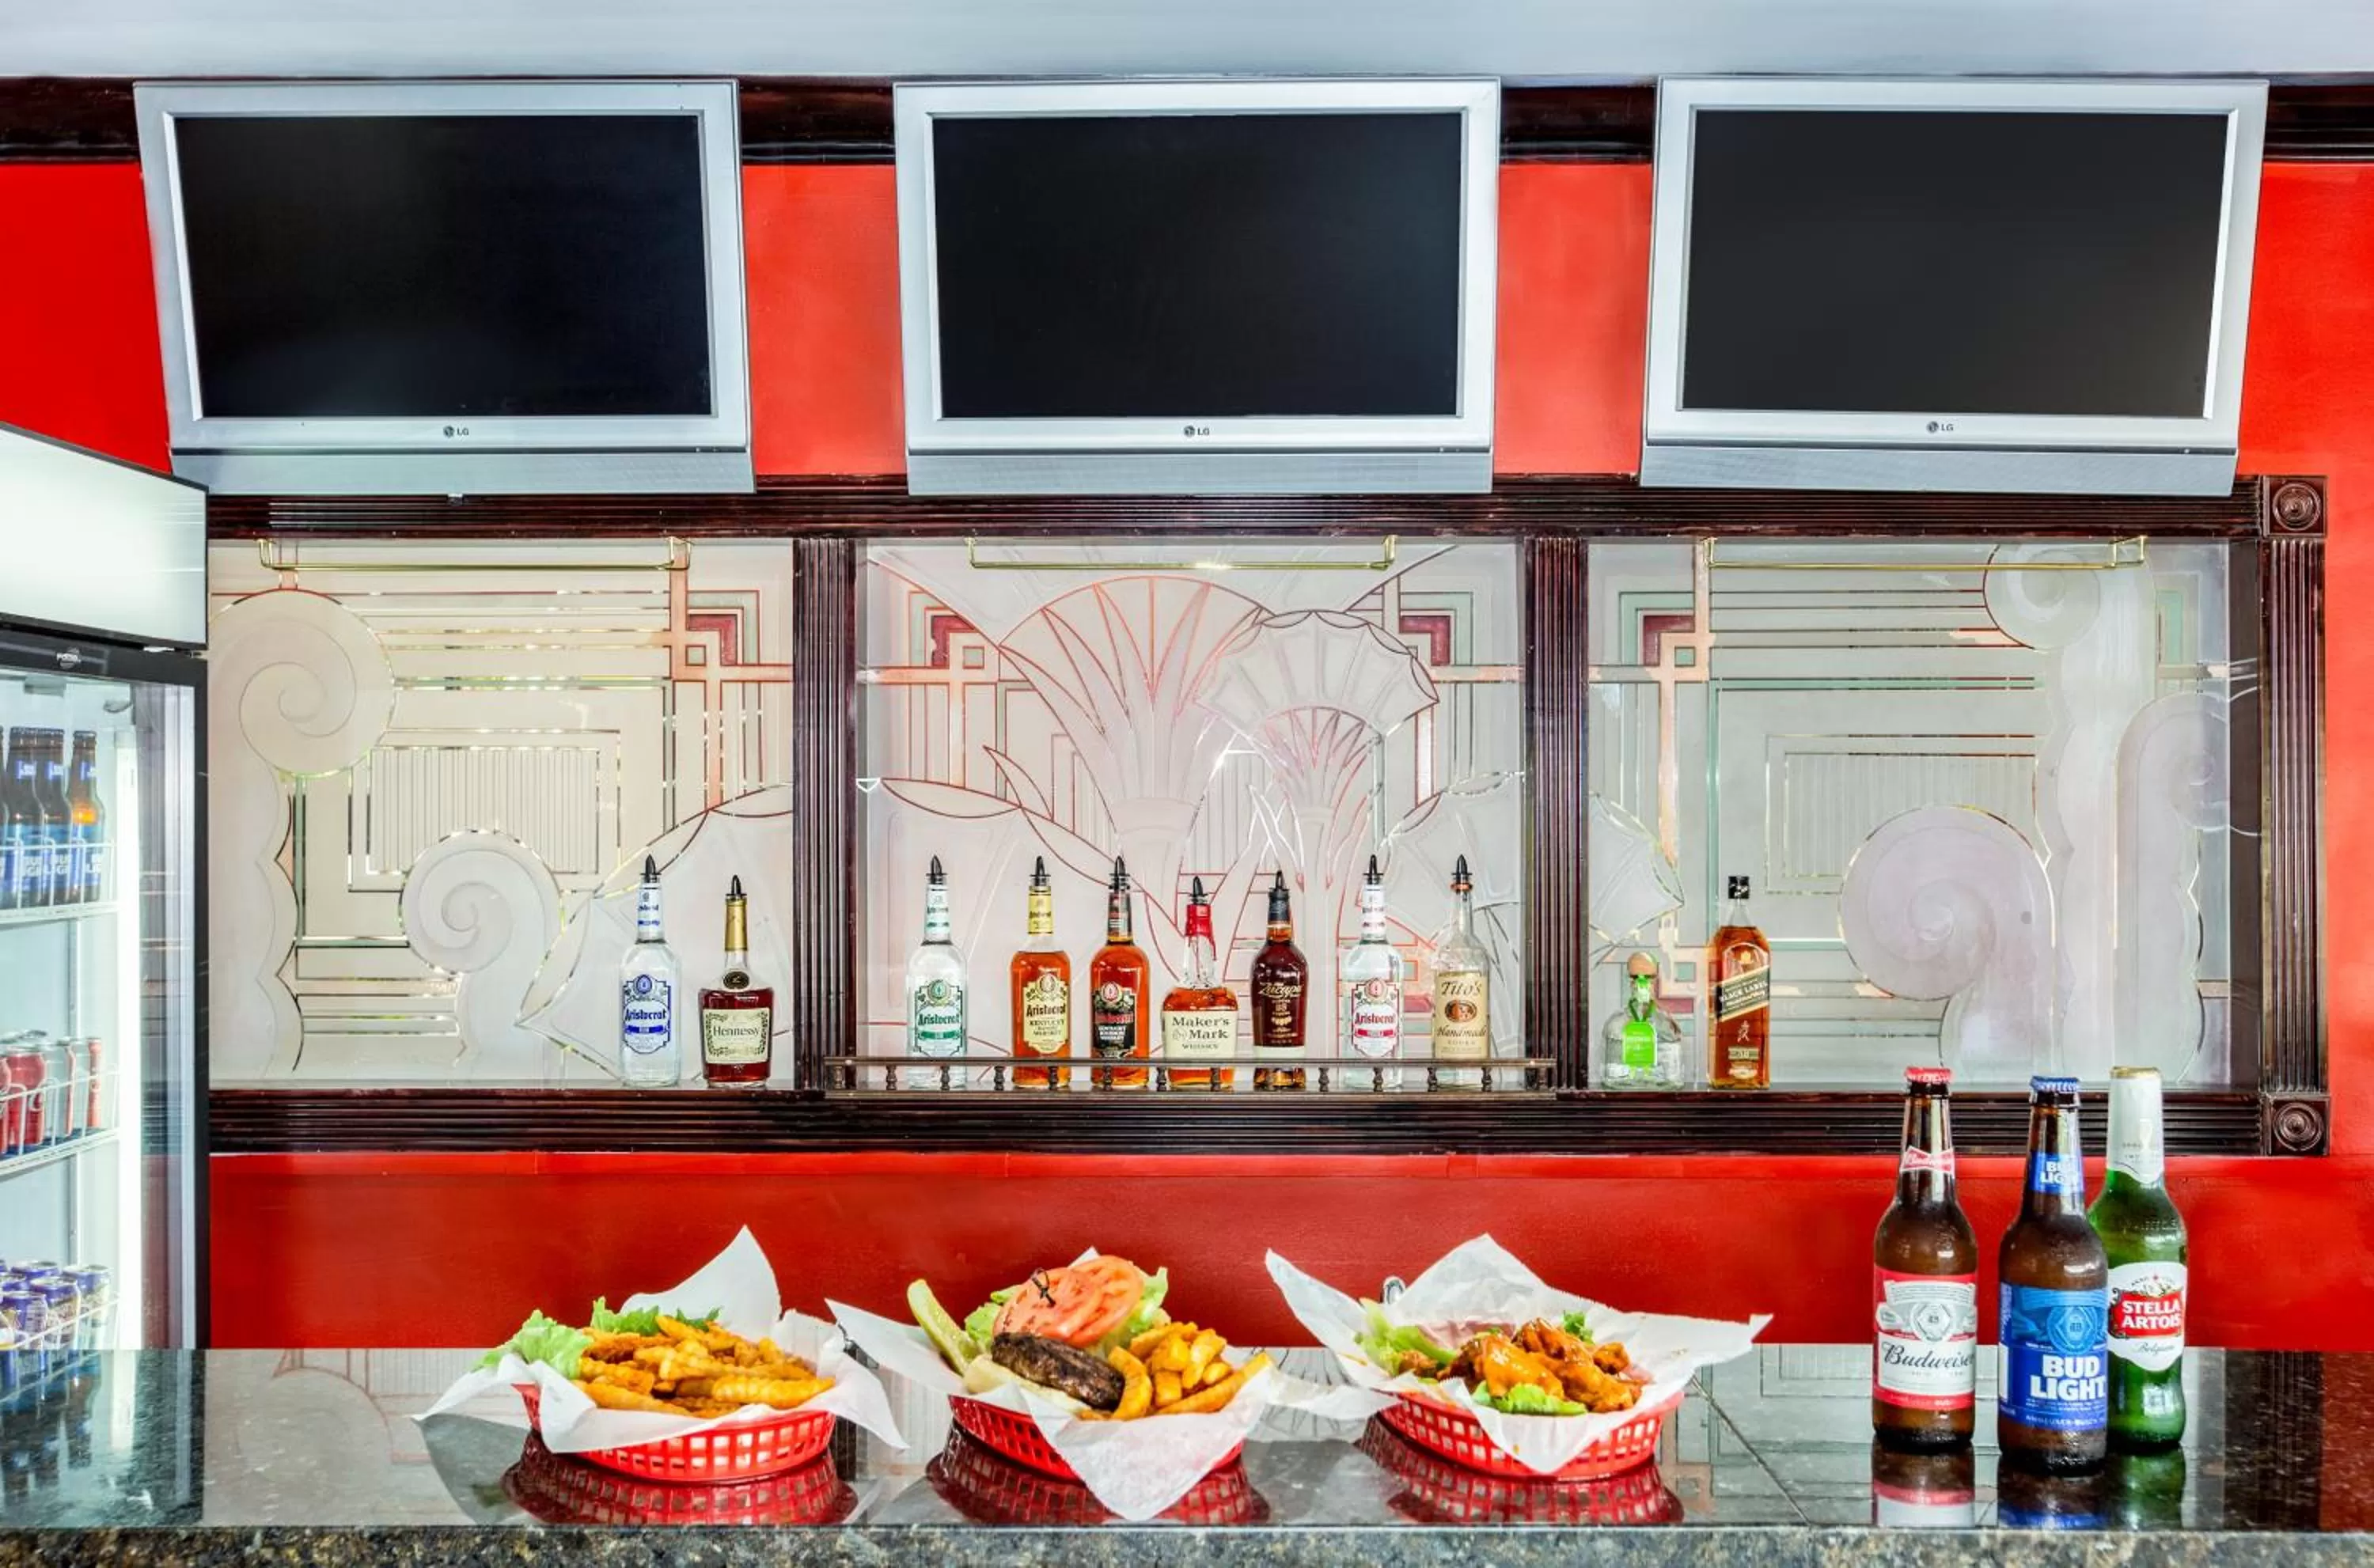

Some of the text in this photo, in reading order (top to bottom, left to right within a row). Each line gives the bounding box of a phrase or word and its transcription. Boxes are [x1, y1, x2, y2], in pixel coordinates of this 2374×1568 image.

[457, 427, 469, 436] LG
[1197, 427, 1210, 436] LG
[624, 1009, 666, 1021] Aristocrat
[918, 1013, 960, 1026] Aristocrat
[1172, 1017, 1230, 1027] Maker's
[713, 1025, 759, 1037] Hennessy
[1189, 1029, 1229, 1039] Mark
[2122, 1298, 2181, 1314] STELLA
[2122, 1313, 2181, 1329] ARTOIS
[2042, 1354, 2100, 1378] BUD
[2031, 1374, 2106, 1400] LIGHT
